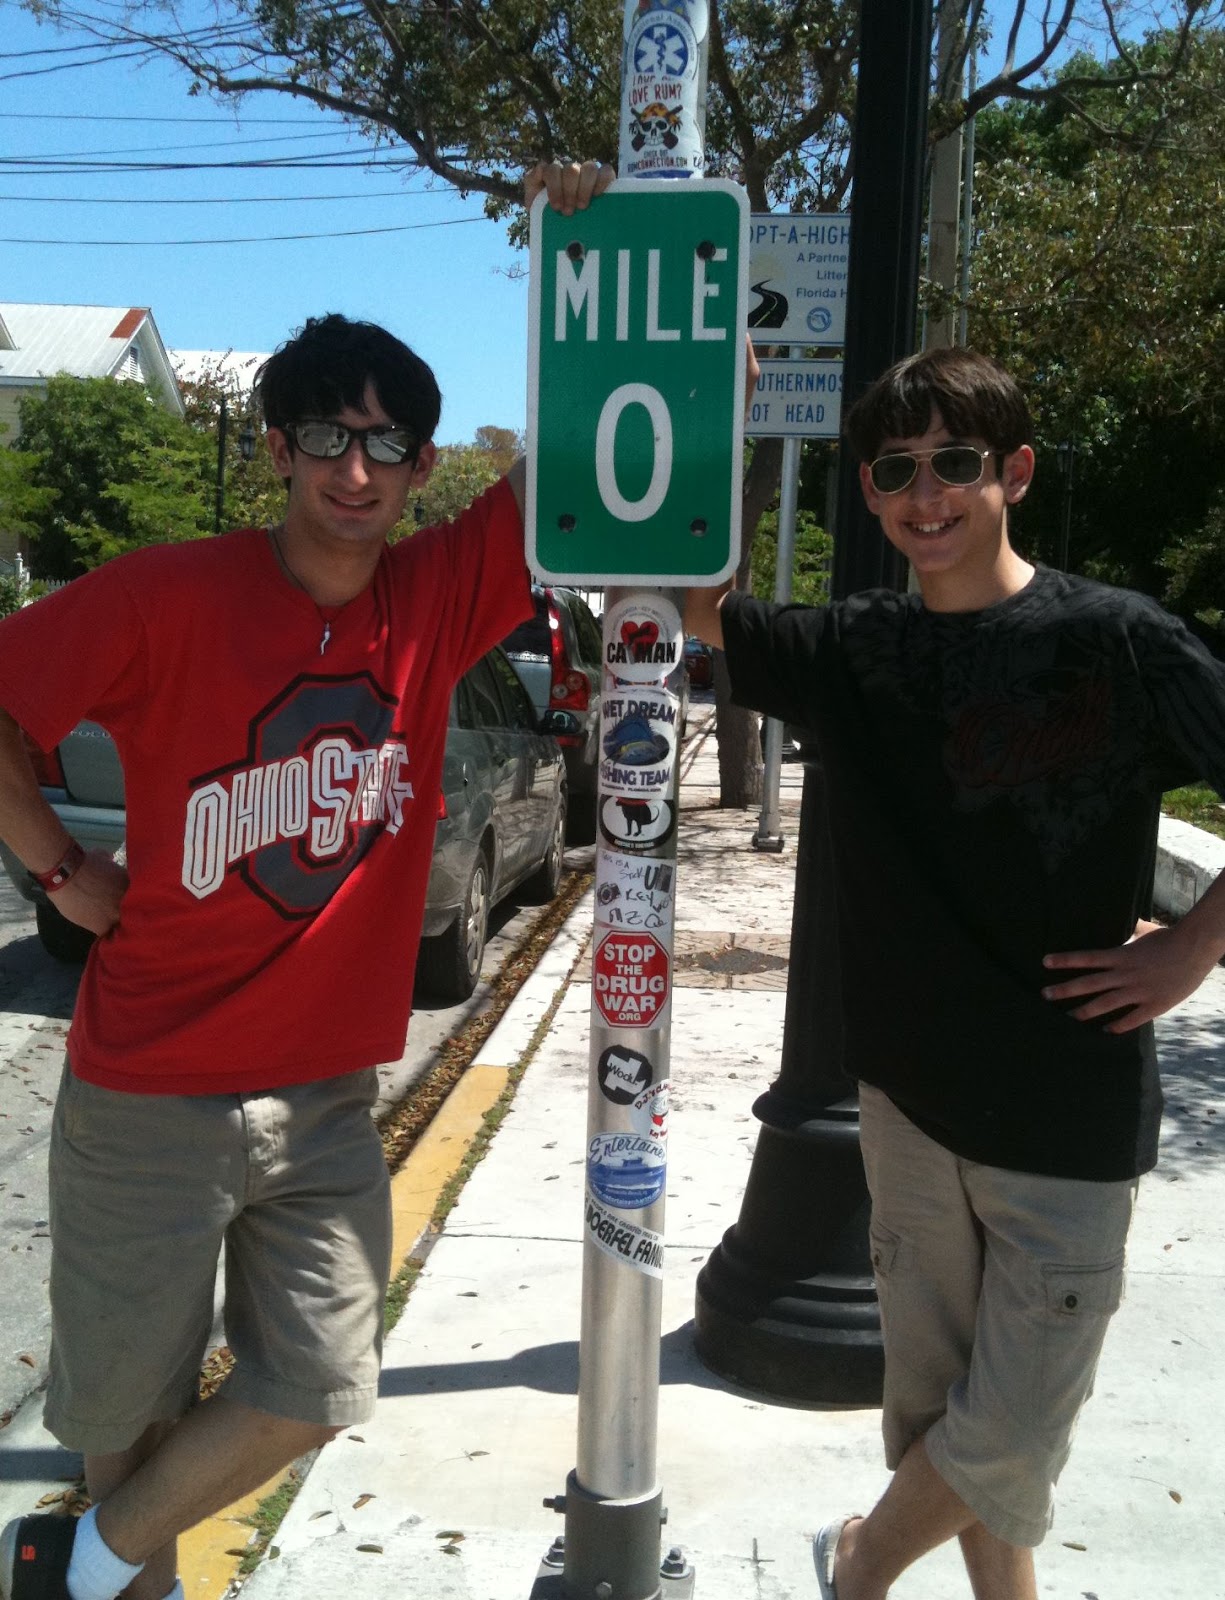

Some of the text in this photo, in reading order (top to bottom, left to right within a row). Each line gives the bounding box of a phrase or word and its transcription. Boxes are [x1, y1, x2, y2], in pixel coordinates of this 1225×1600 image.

[629, 83, 682, 106] LOVE RUM?
[797, 253, 847, 264] A Partne
[817, 271, 847, 280] Litter
[555, 249, 727, 341] MILE
[797, 288, 837, 299] Florida
[747, 403, 825, 423] OT HEAD
[595, 382, 673, 522] 0
[640, 767, 670, 786] TEAM
[182, 756, 309, 900] OHIO
[604, 943, 656, 963] STOP
[616, 964, 643, 975] THE
[596, 973, 665, 995] DRUG
[602, 994, 656, 1012] WAR
[616, 1012, 641, 1021] .ORG
